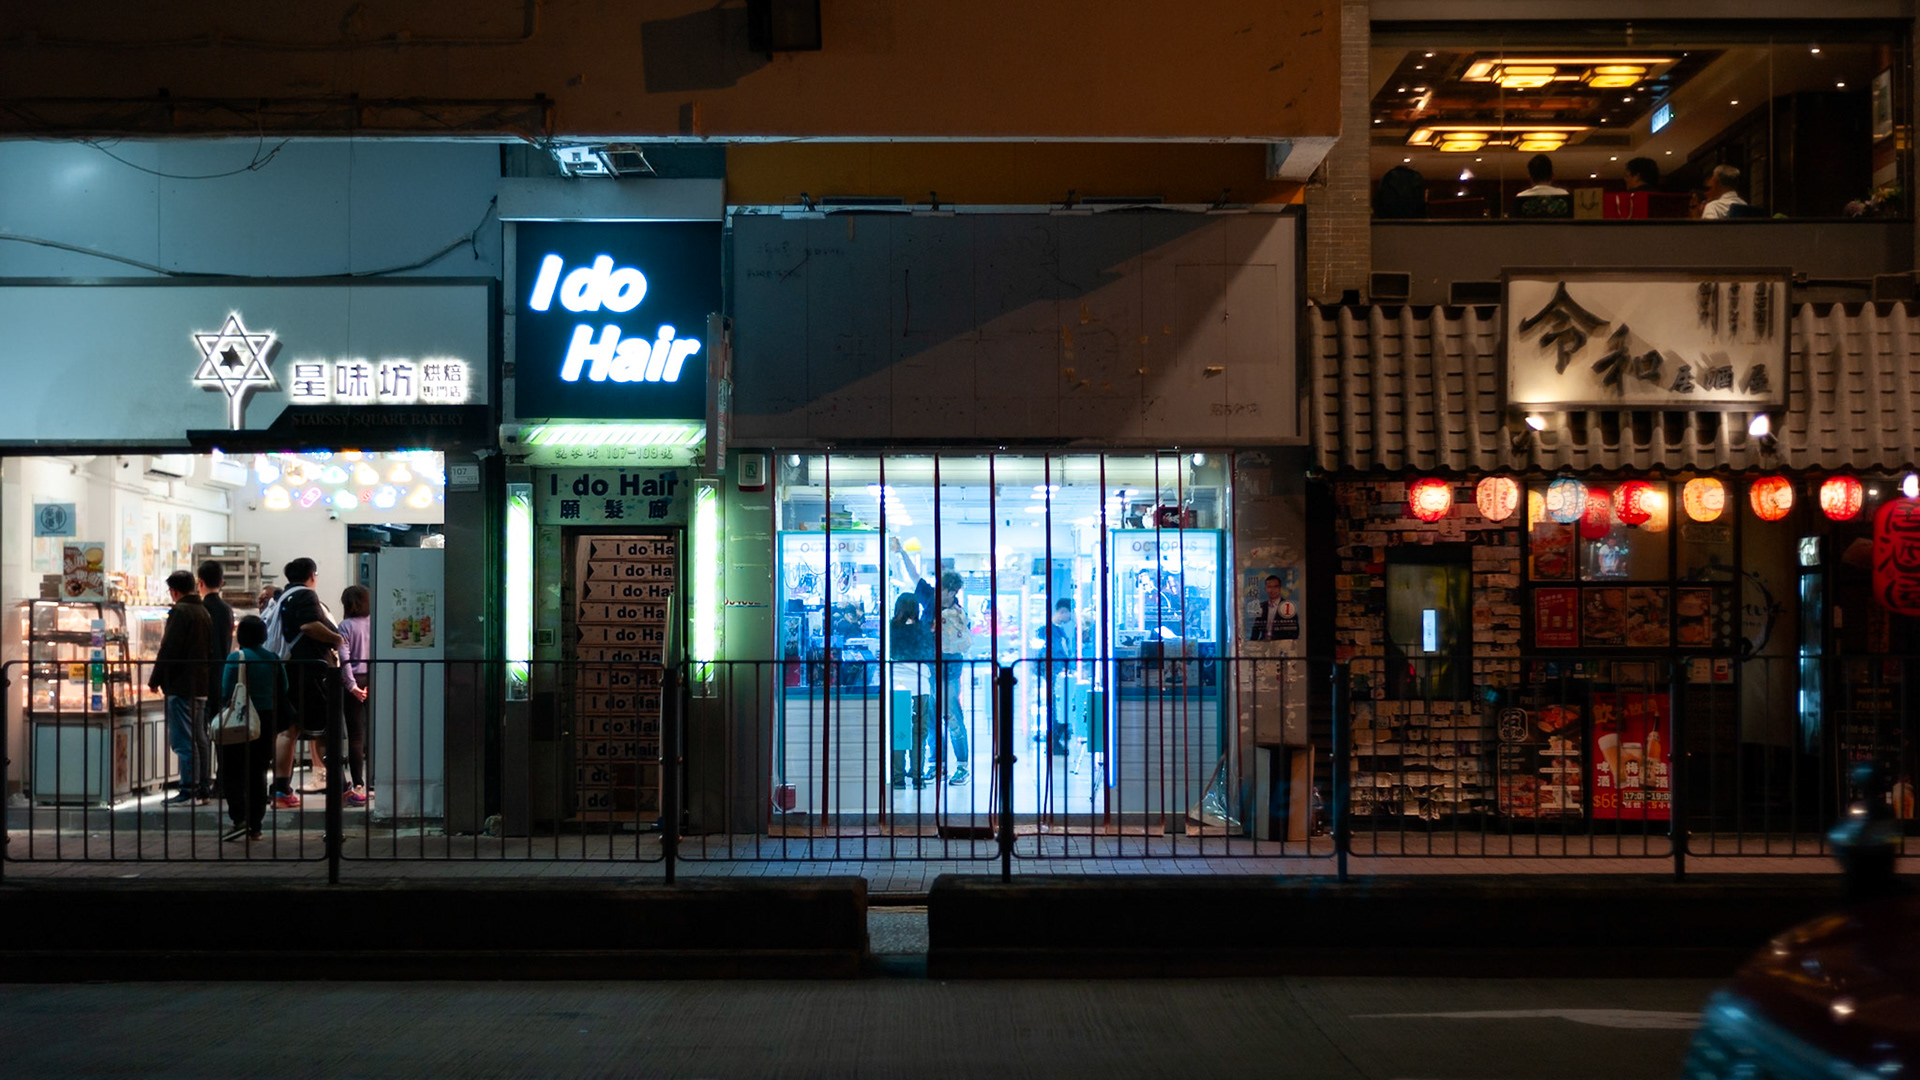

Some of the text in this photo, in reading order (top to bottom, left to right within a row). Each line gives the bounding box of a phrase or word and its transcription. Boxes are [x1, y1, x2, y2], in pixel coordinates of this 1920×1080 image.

[530, 254, 647, 312] I do
[1519, 281, 1664, 397] 令和
[1668, 364, 1773, 395] 居酒屋
[561, 324, 701, 382] Hair
[423, 364, 461, 382] 烘焙
[292, 363, 412, 397] 星味坊
[353, 414, 407, 426] SQUARE
[412, 414, 465, 426] BAKERY
[452, 467, 467, 475] 107
[551, 473, 679, 496] I do Hair
[628, 544, 647, 556] do
[625, 565, 645, 577] do
[623, 585, 643, 597] do
[617, 606, 637, 618] do
[1284, 603, 1291, 616] 1
[616, 628, 636, 641] do
[612, 650, 632, 661] do
[630, 719, 660, 732] Hai
